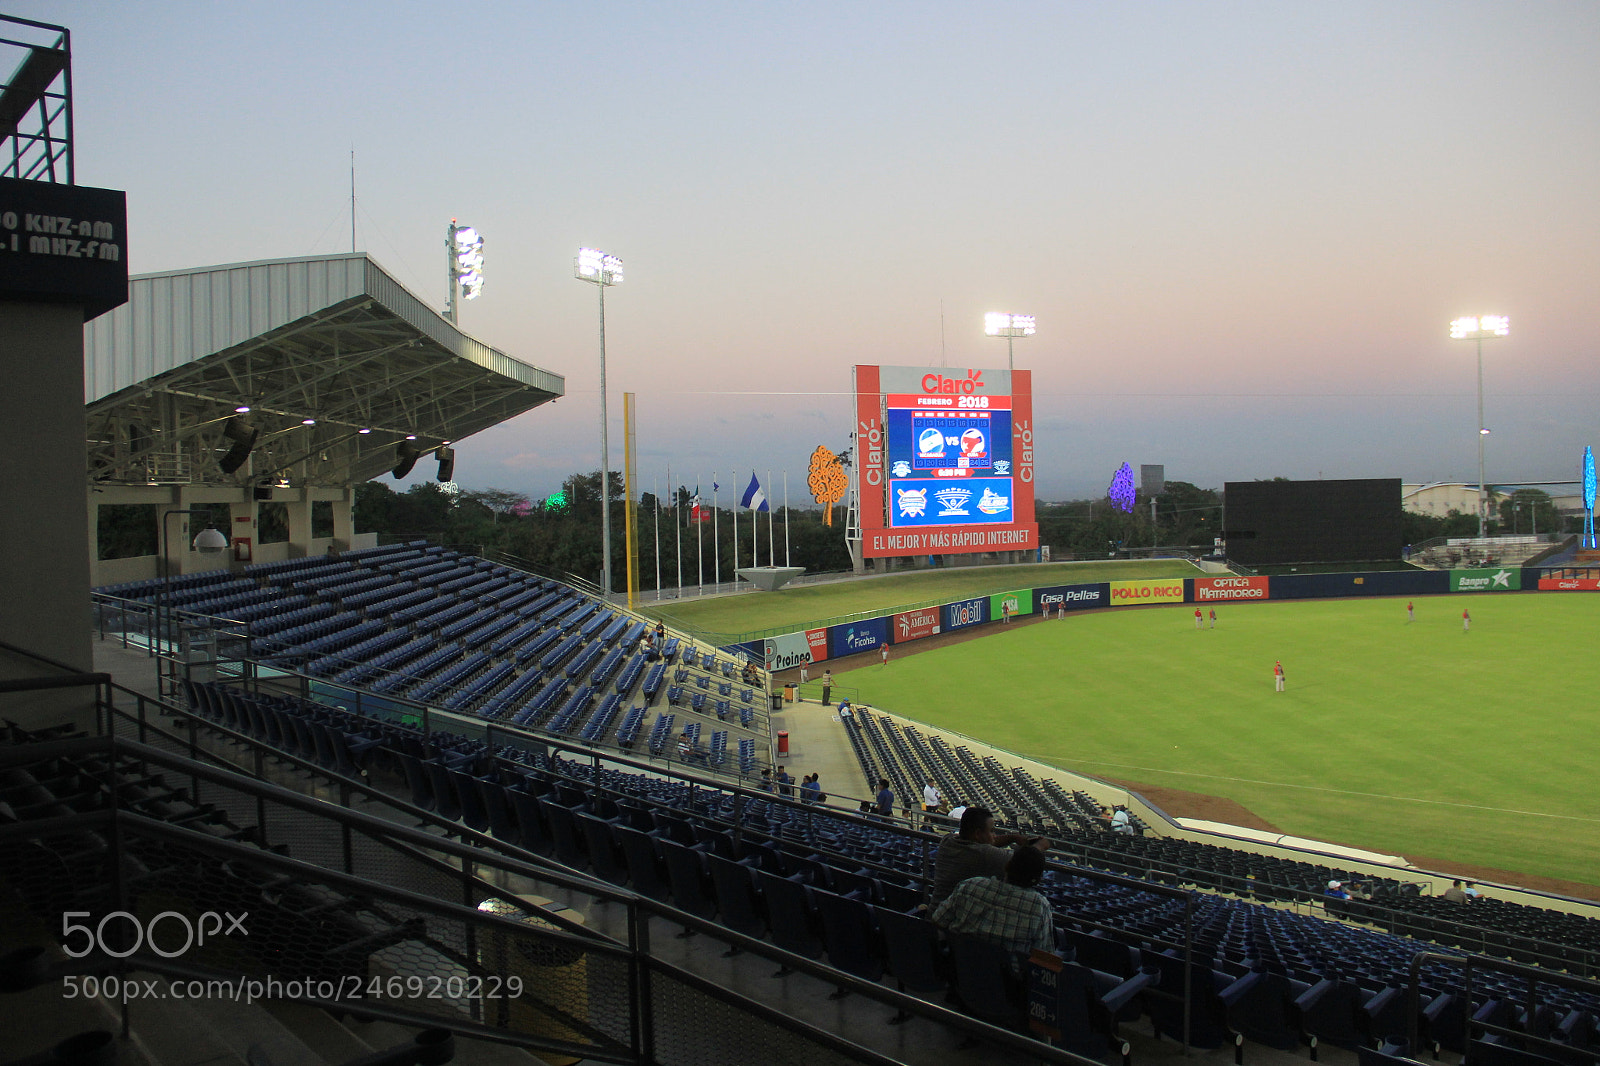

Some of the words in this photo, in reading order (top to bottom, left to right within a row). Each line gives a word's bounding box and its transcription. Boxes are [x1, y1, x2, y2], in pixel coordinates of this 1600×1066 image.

[0, 211, 18, 230] 0
[921, 370, 980, 394] Claro
[958, 396, 989, 408] 2018
[945, 436, 960, 446] VS
[865, 427, 882, 486] Claro
[1018, 426, 1032, 483] Claro
[873, 536, 886, 550] EL
[888, 533, 920, 549] MEJOR
[921, 534, 928, 547] Y
[930, 531, 949, 547] MÁS
[952, 530, 985, 546] RÁPIDO
[987, 529, 1030, 545] INTERNET
[1213, 578, 1249, 588] OPTICA
[1459, 577, 1489, 587] Banpro
[1040, 593, 1064, 604] Casa
[1066, 590, 1100, 601] Pellas
[1112, 587, 1151, 599] POLLO
[1154, 586, 1183, 597] RICO
[951, 601, 981, 627] Mobil
[854, 636, 876, 648] Ficohsa
